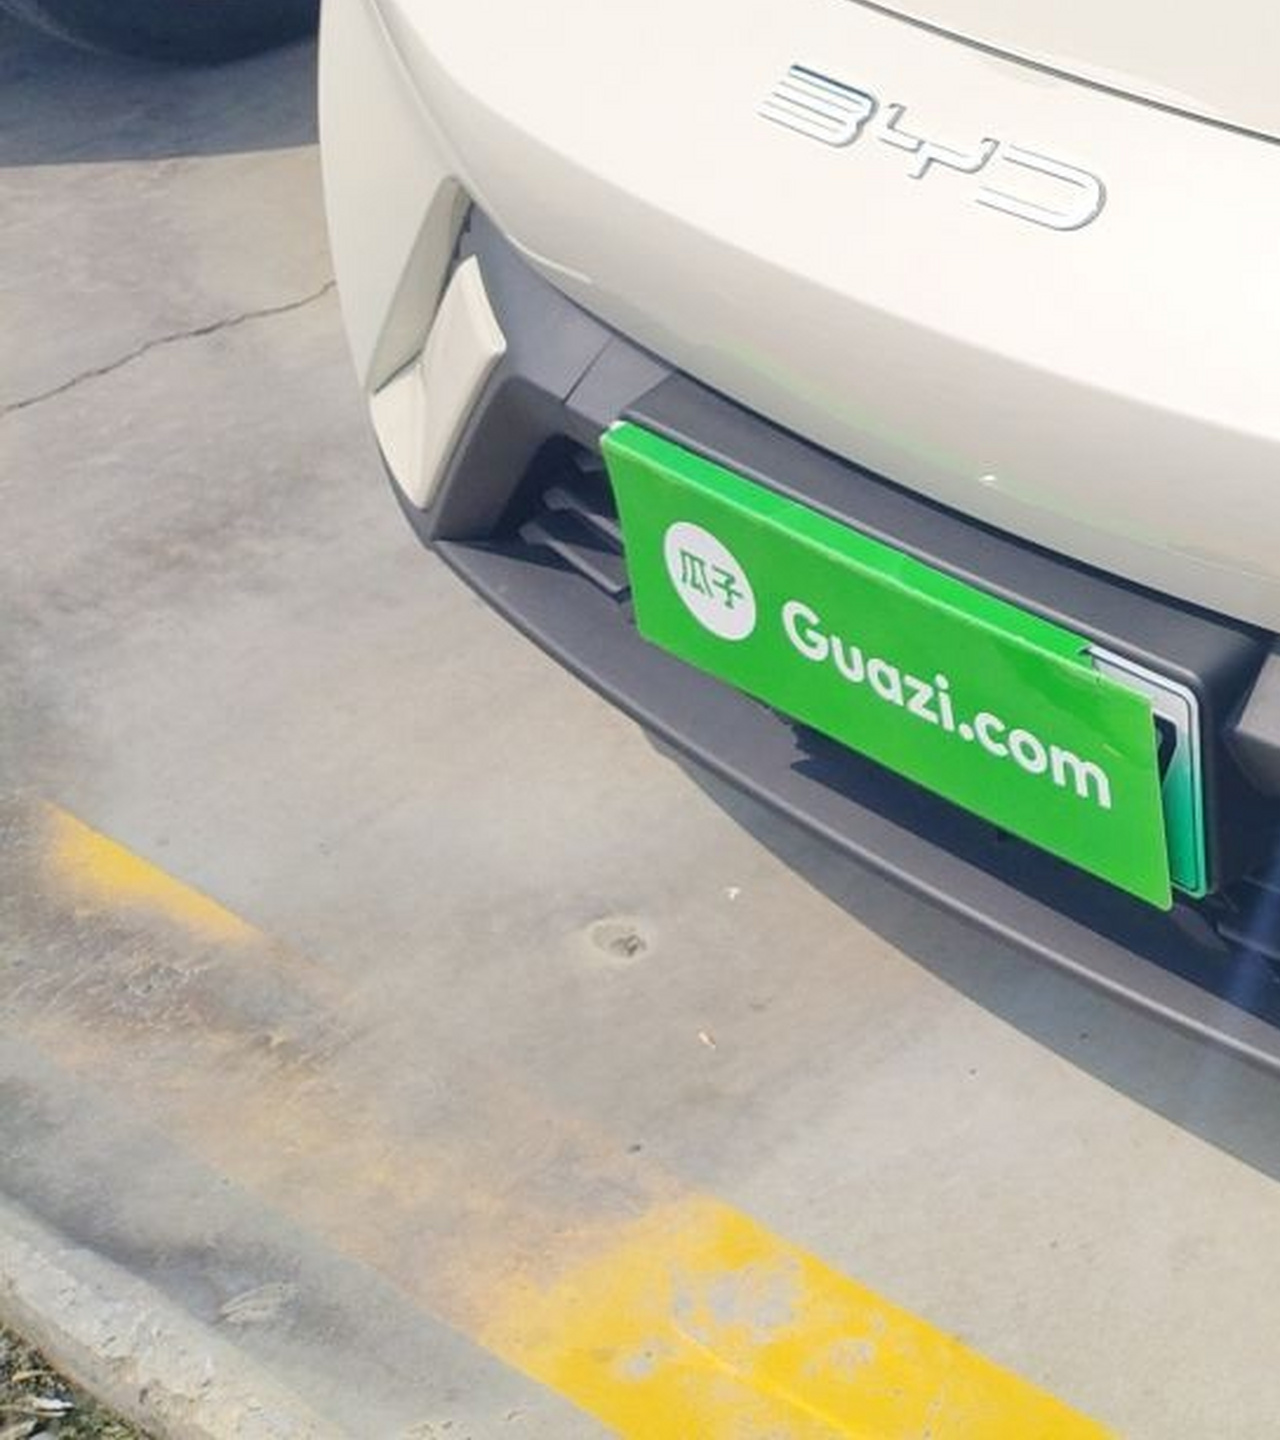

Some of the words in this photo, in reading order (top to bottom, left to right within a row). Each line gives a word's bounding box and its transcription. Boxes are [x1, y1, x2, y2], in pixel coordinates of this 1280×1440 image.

[757, 63, 1108, 233] BYD
[679, 548, 744, 610] 瓜子
[781, 599, 1112, 810] Guazi.com
